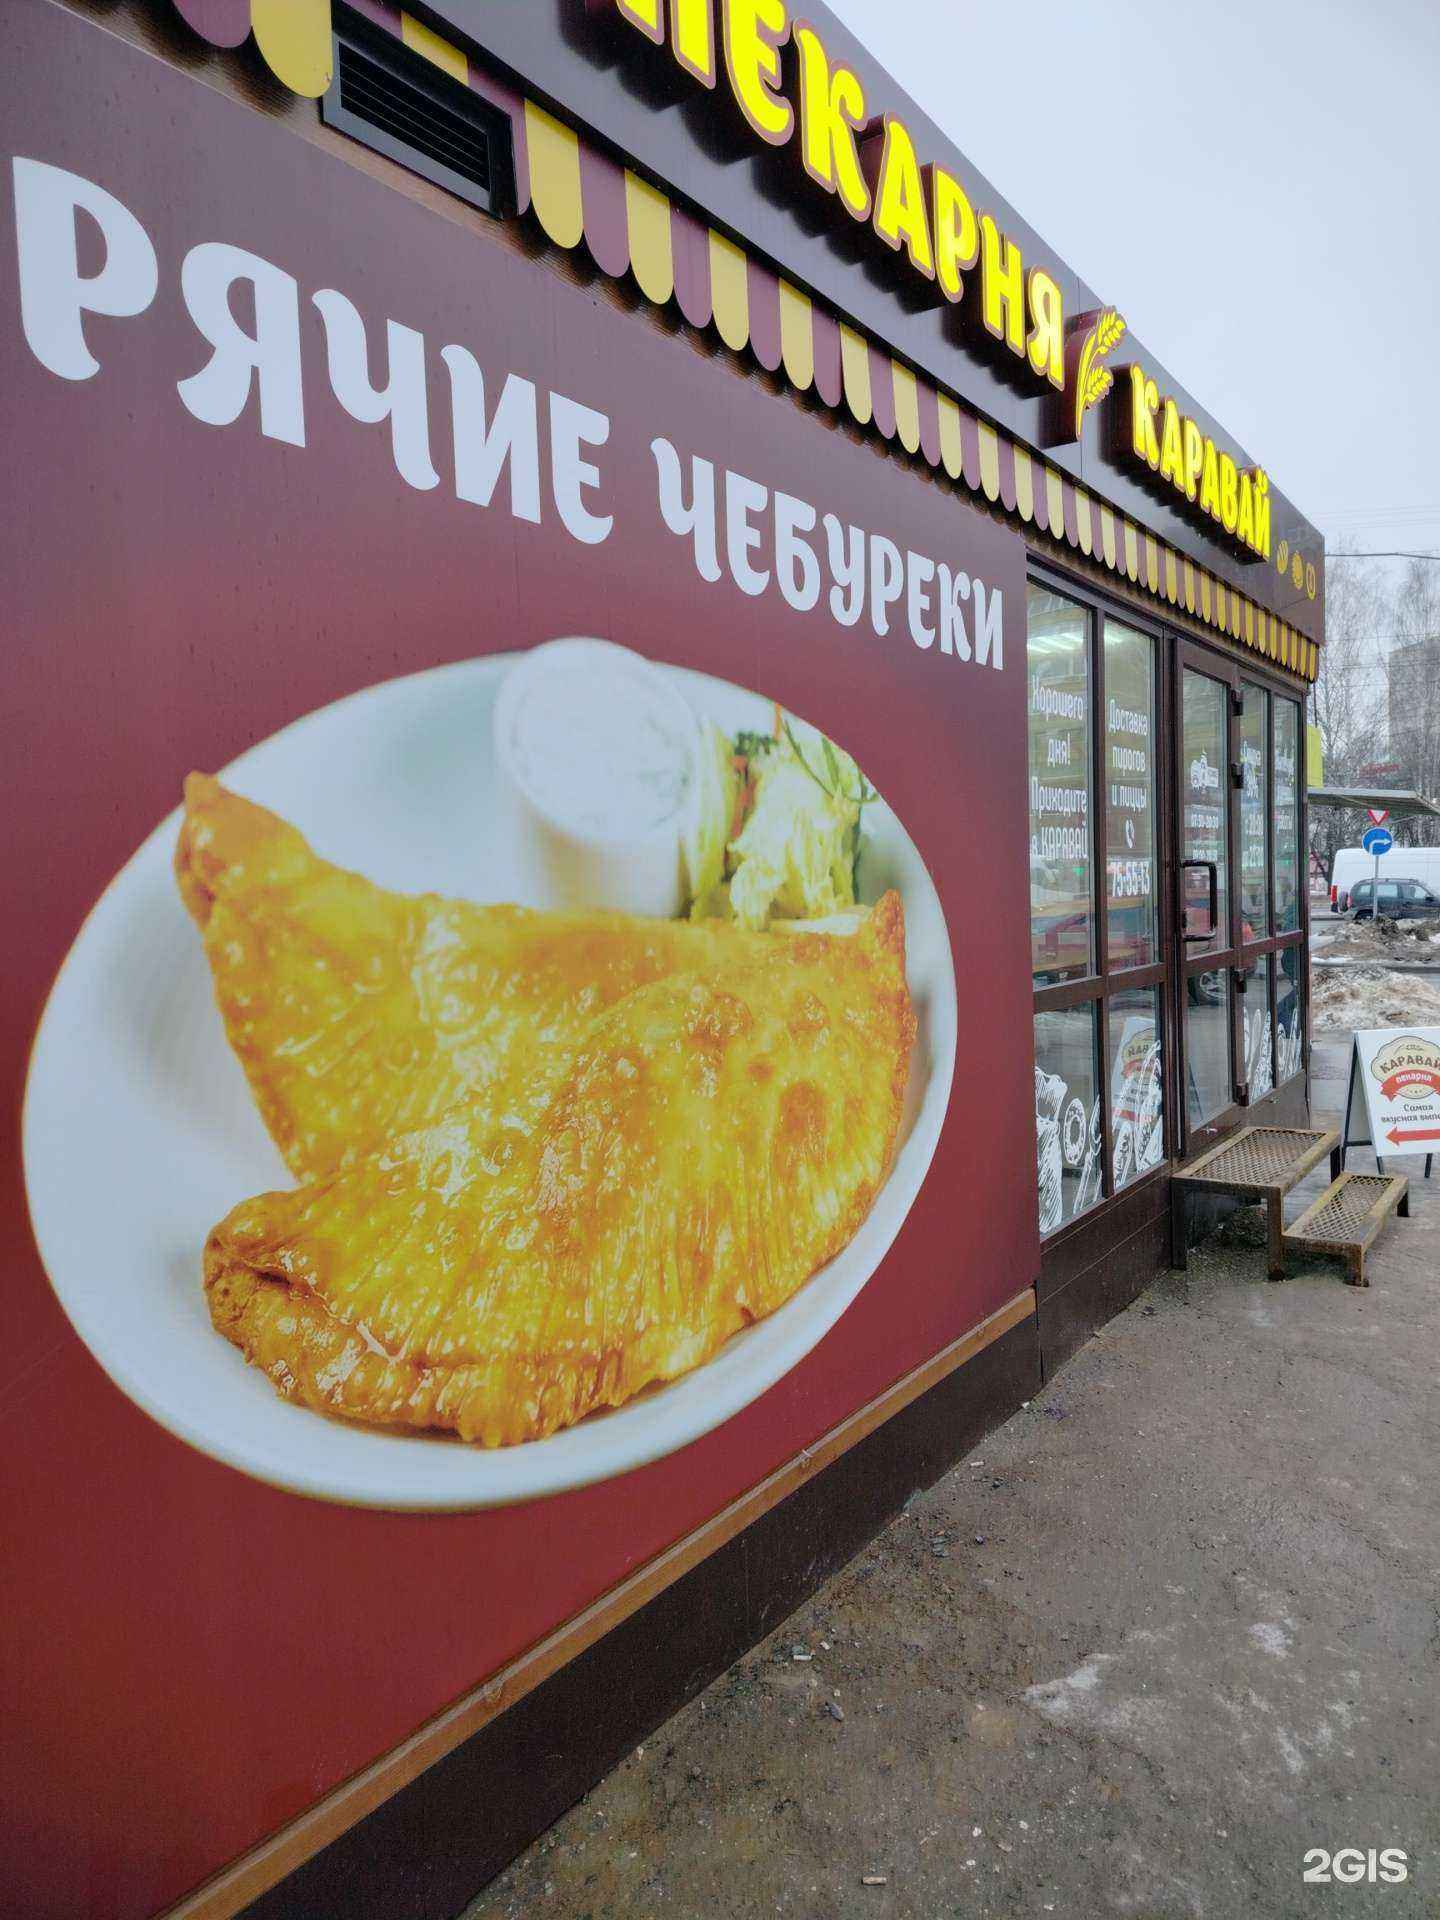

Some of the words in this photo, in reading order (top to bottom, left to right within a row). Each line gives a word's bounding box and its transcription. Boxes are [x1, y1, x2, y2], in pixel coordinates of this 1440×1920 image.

[12, 156, 613, 544] РЯЧИЕ
[651, 437, 1004, 671] ЧЕБУРЕКИ
[1131, 362, 1270, 562] КАРАВАЙ
[1032, 675, 1084, 721] Хорошего
[1109, 699, 1148, 736] Доставка
[1047, 733, 1071, 767] дня!
[1112, 745, 1146, 776] пирогов
[1031, 776, 1087, 818] Приходите
[1041, 821, 1088, 859] КАРАВАЙ
[1381, 1114, 1418, 1124] вкусная
[1403, 1103, 1433, 1112] Самая
